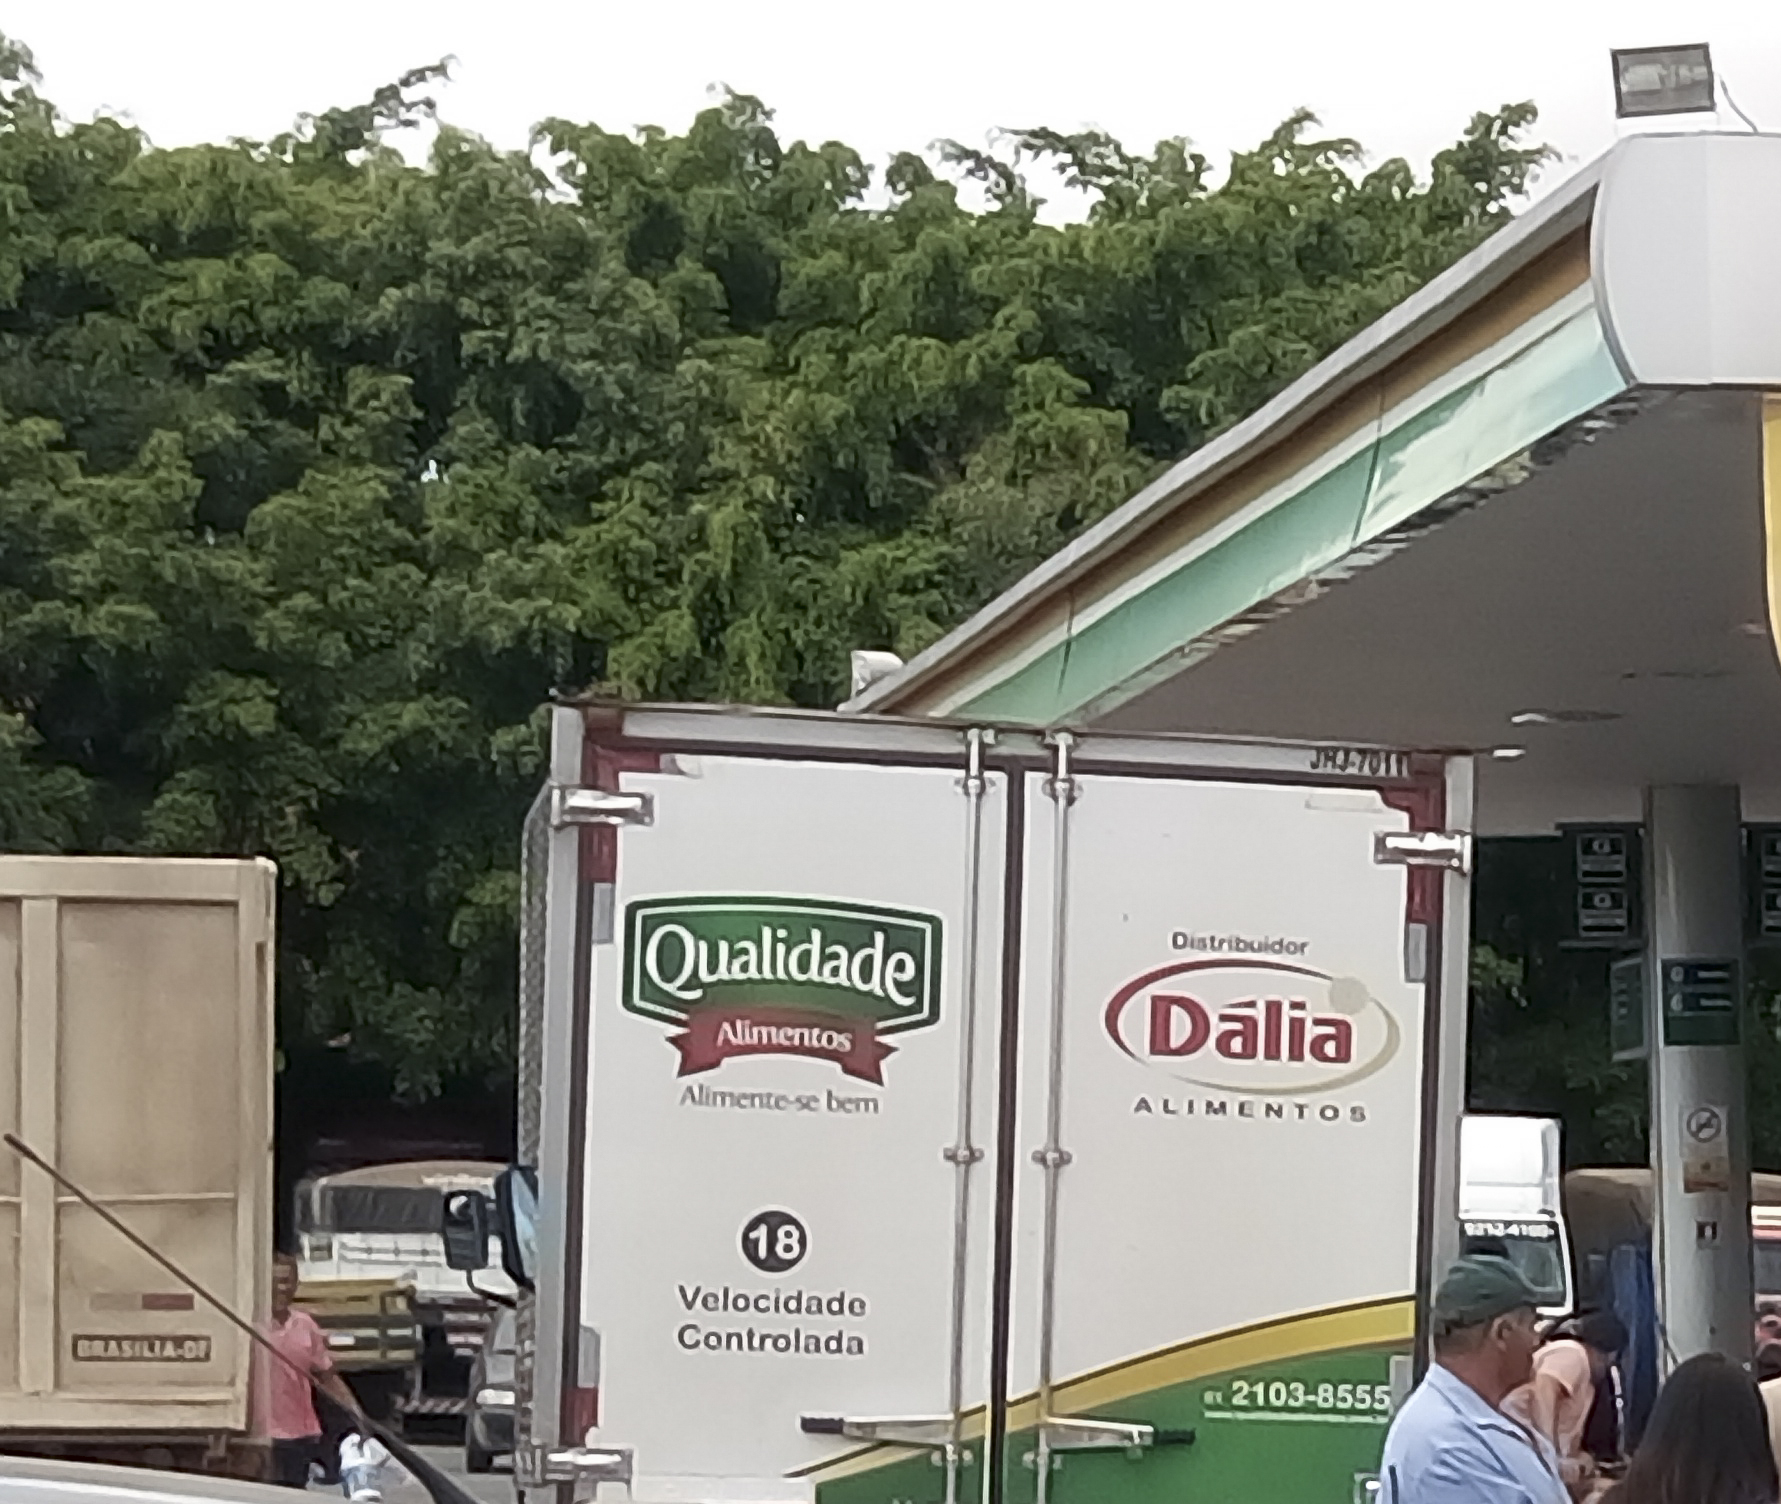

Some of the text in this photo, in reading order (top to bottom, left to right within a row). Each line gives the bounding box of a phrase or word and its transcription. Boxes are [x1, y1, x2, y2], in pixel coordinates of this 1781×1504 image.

[1172, 932, 1310, 956] Distribuidor
[645, 923, 917, 1006] Qualidade
[716, 1018, 853, 1052] Alimentos
[1150, 994, 1353, 1064] Dália
[826, 1089, 880, 1114] bem
[1133, 1097, 1367, 1124] ALIMENTOS
[748, 1222, 802, 1261] 18
[677, 1284, 867, 1318] Velocidade
[677, 1323, 865, 1356] Controlada
[1231, 1380, 1391, 1410] 2103-8555
